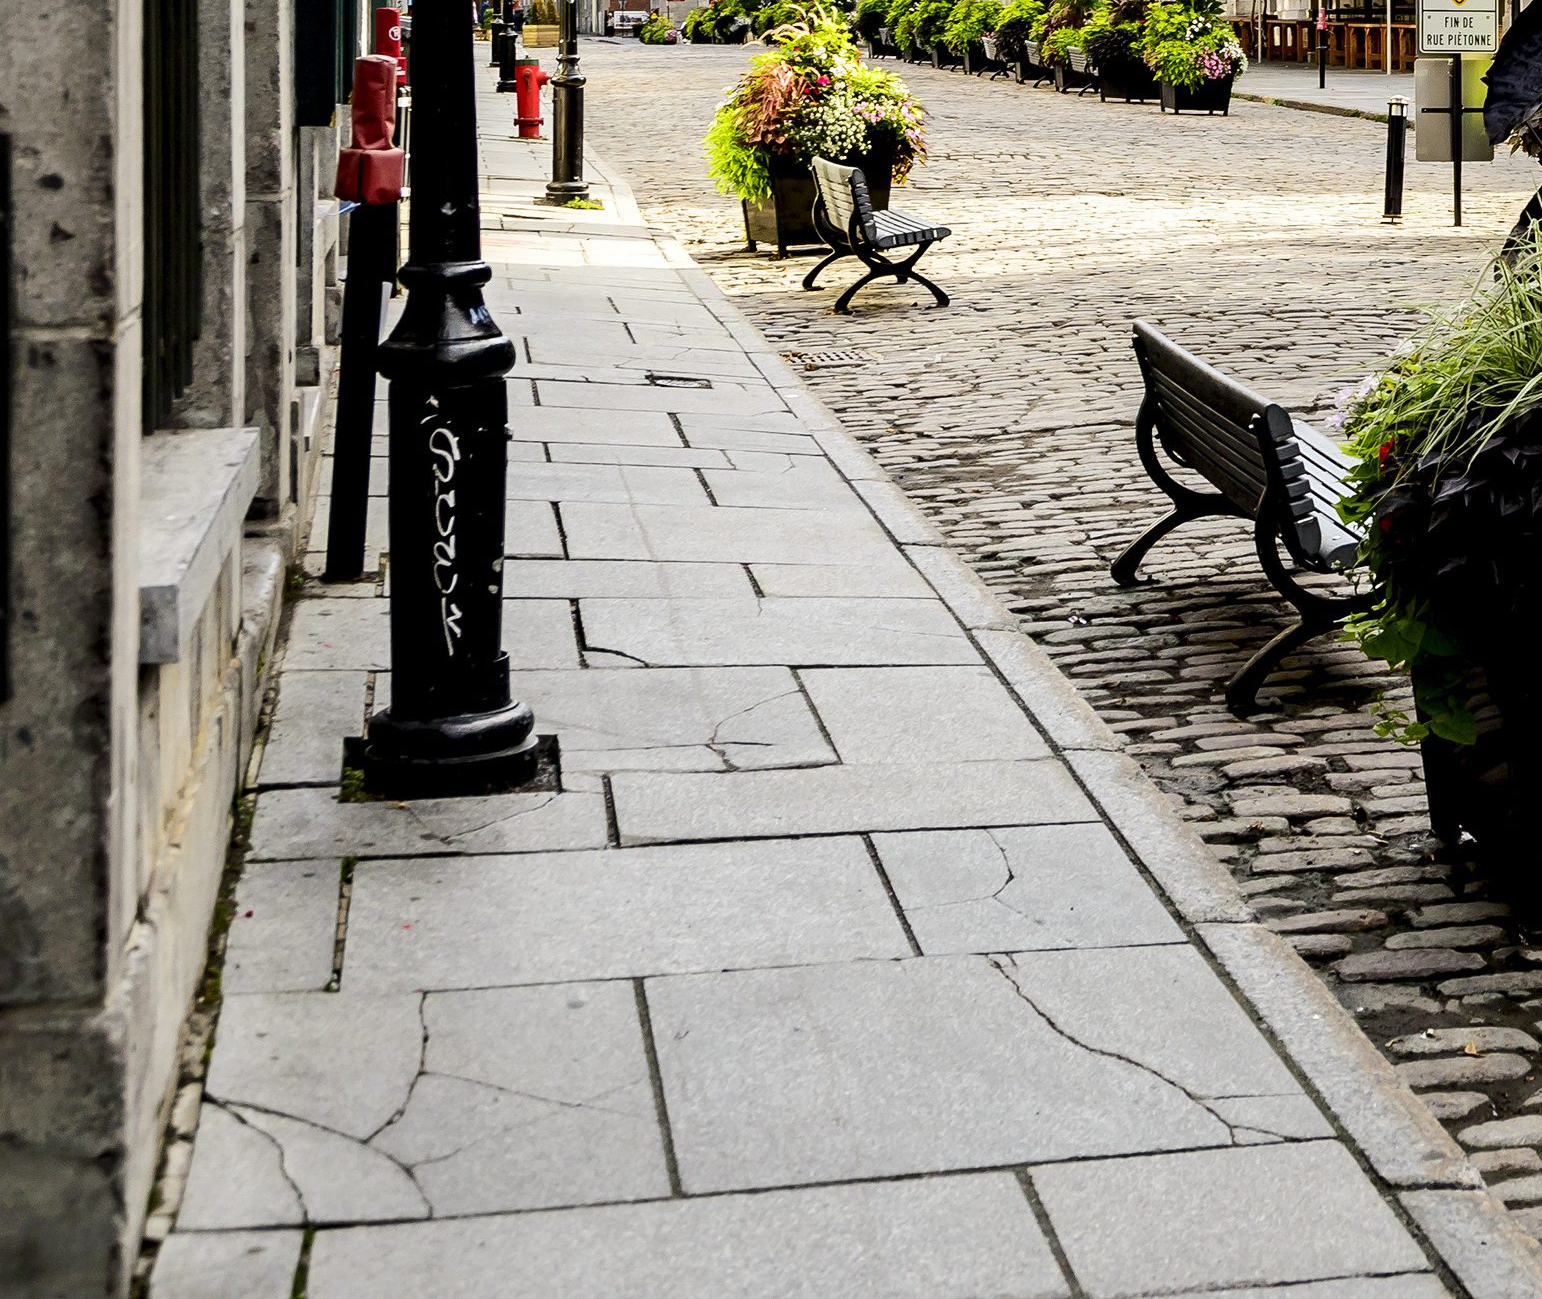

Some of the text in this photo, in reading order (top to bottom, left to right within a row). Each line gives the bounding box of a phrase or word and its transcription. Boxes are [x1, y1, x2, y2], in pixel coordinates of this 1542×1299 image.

[1444, 16, 1474, 29] FIN DE
[1426, 33, 1444, 46] RUE
